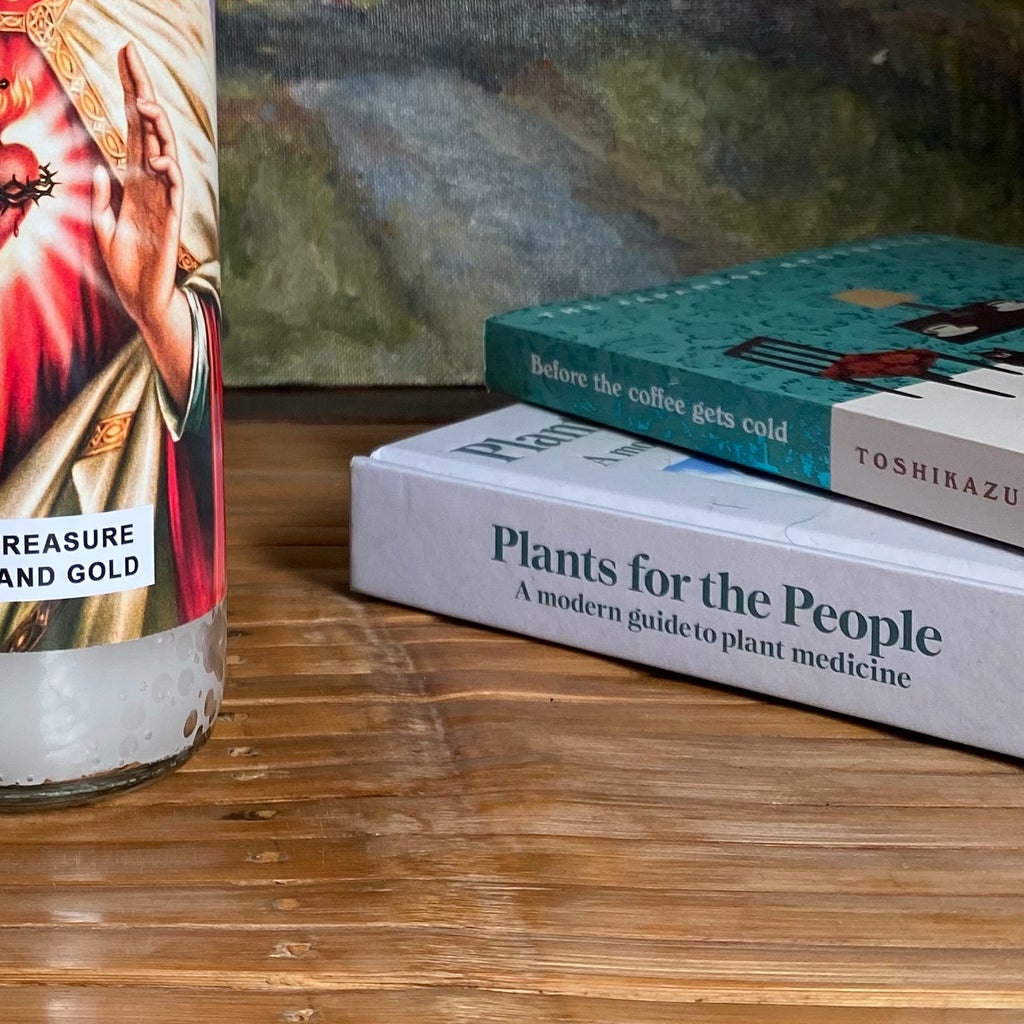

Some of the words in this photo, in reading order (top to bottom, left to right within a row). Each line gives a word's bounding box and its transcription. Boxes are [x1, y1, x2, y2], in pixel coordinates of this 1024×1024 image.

[530, 352, 588, 388] Before
[593, 373, 622, 397] the
[628, 385, 686, 415] coffee
[692, 401, 736, 429] gets
[742, 417, 788, 443] cold
[449, 418, 600, 463] Plan
[855, 446, 1019, 506] TOSHIKAZU
[67, 555, 139, 584] GOLD
[491, 524, 617, 587] Plants
[628, 553, 691, 602] for
[699, 572, 771, 619] the
[781, 583, 943, 659] People
[515, 580, 531, 601] A
[537, 588, 622, 622] modern
[628, 608, 691, 638] guide
[721, 628, 785, 660] plant
[791, 646, 912, 688] medicine
